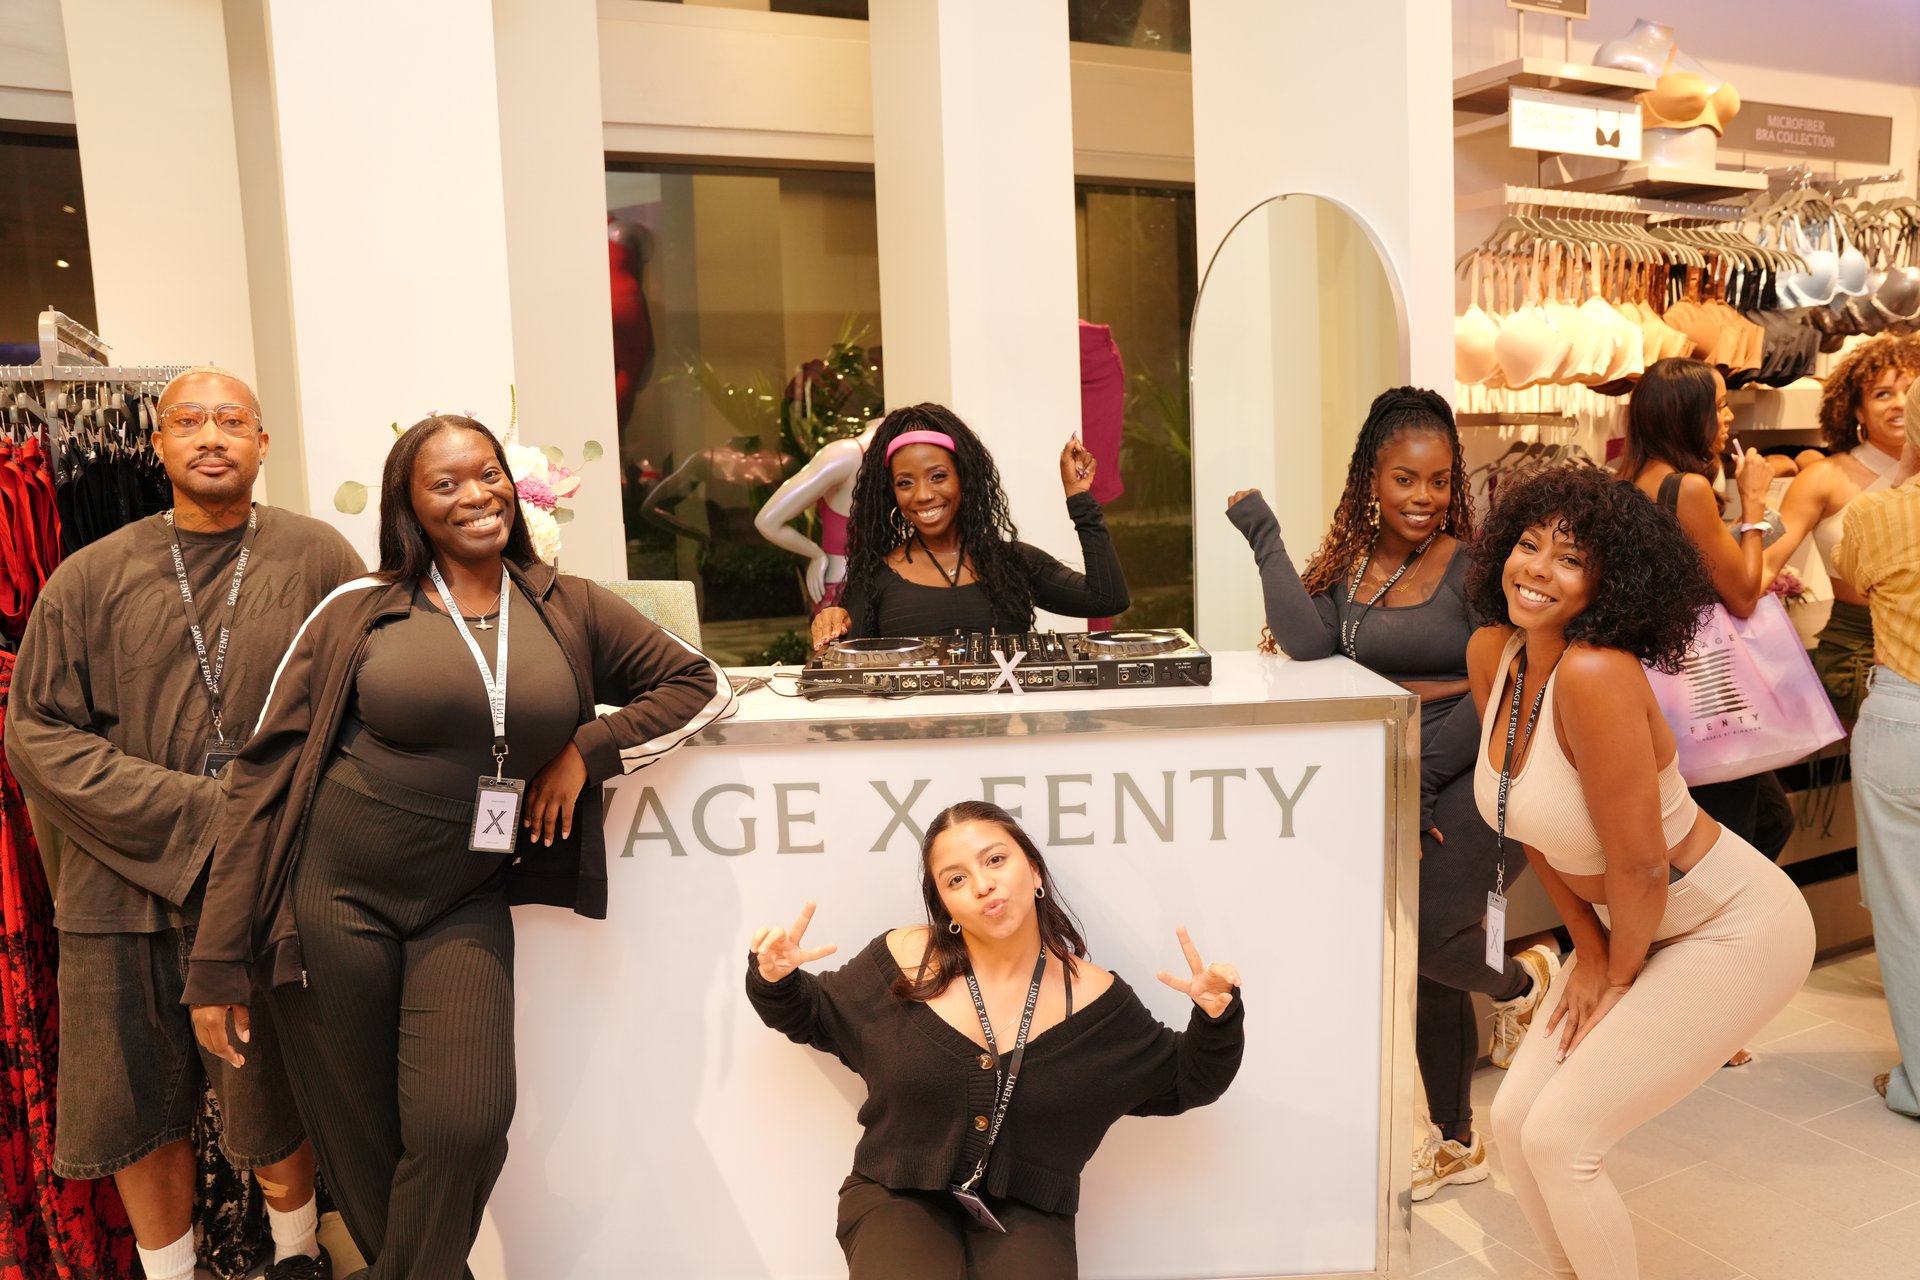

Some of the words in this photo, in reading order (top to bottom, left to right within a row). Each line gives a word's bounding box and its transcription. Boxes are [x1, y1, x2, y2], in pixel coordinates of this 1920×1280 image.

[1755, 128, 1775, 142] BRA
[1776, 130, 1835, 148] COLLECTION
[1767, 114, 1825, 132] MICROFIBER
[171, 544, 184, 572] SAVAGE
[180, 580, 192, 603] FENTY
[227, 578, 241, 606] SAVAGE
[237, 547, 250, 571] FENTY
[1390, 565, 1406, 582] FENTY
[190, 624, 206, 656] SAVAGE
[202, 664, 214, 690] FENTY
[212, 662, 224, 694] SAVAGE
[218, 627, 230, 654] FENTY
[988, 650, 1028, 696] X
[1512, 672, 1524, 706] SAVAGE
[1508, 717, 1517, 746] FENTY
[1690, 713, 1758, 734] FENTY
[1498, 771, 1508, 804] SAVAGE
[482, 809, 507, 835] X
[603, 782, 824, 858] AGE
[868, 779, 932, 852] X
[980, 765, 1322, 847] FENTY
[1490, 925, 1500, 953] X
[966, 976, 983, 1007] SAVAGE
[980, 1017, 995, 1044] FENTY
[1016, 1017, 1031, 1050] SAVAGE
[1026, 981, 1040, 1008] FENTY
[989, 1112, 1004, 1146] SAVAGE
[1002, 1073, 1016, 1102] FENTY
